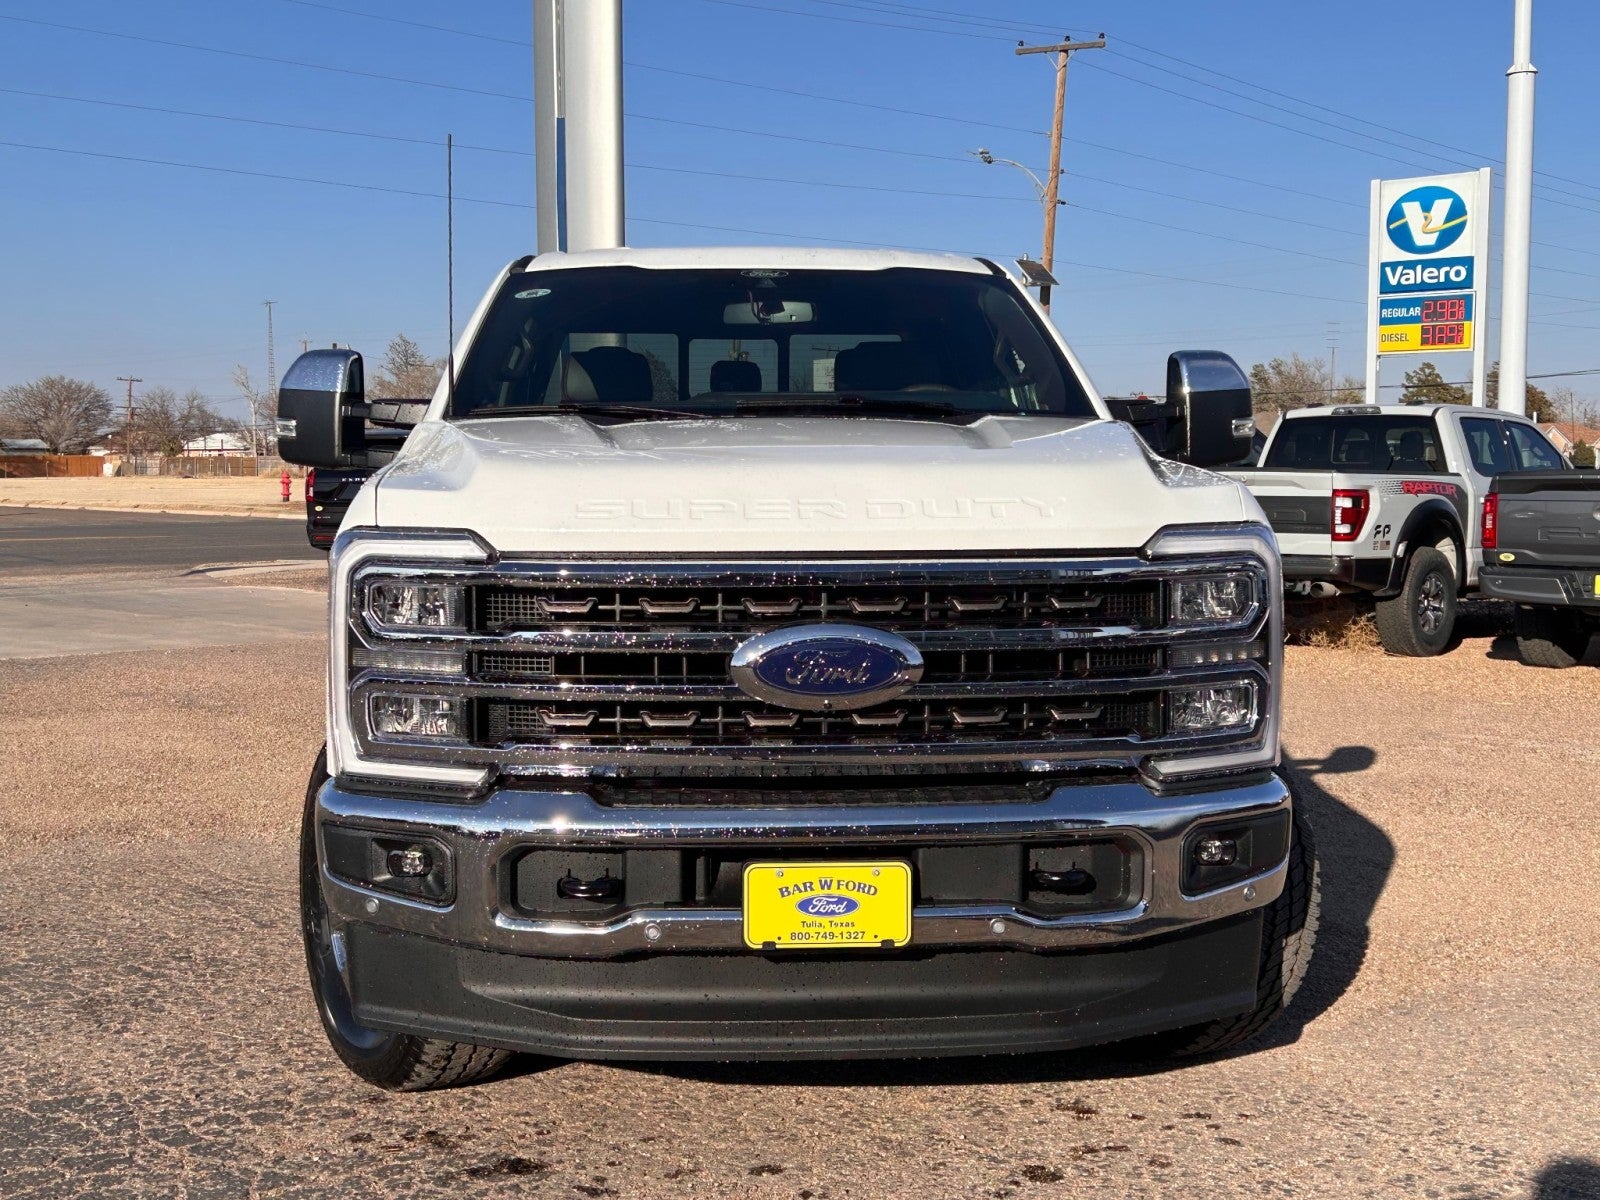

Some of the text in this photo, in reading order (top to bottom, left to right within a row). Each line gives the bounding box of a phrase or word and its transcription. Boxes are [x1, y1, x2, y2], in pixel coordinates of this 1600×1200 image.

[1385, 265, 1467, 286] Valero
[1381, 307, 1421, 318] REGULAR
[1381, 333, 1409, 343] DIESEL
[1402, 481, 1459, 499] RAPTOR
[575, 496, 1066, 520] SUPER DUTY
[785, 649, 871, 685] Ford
[778, 877, 878, 898] BAR W FORD
[808, 897, 848, 914] Ford
[800, 920, 855, 929] Tulia, Texas
[790, 931, 866, 941] 800-749-1327
